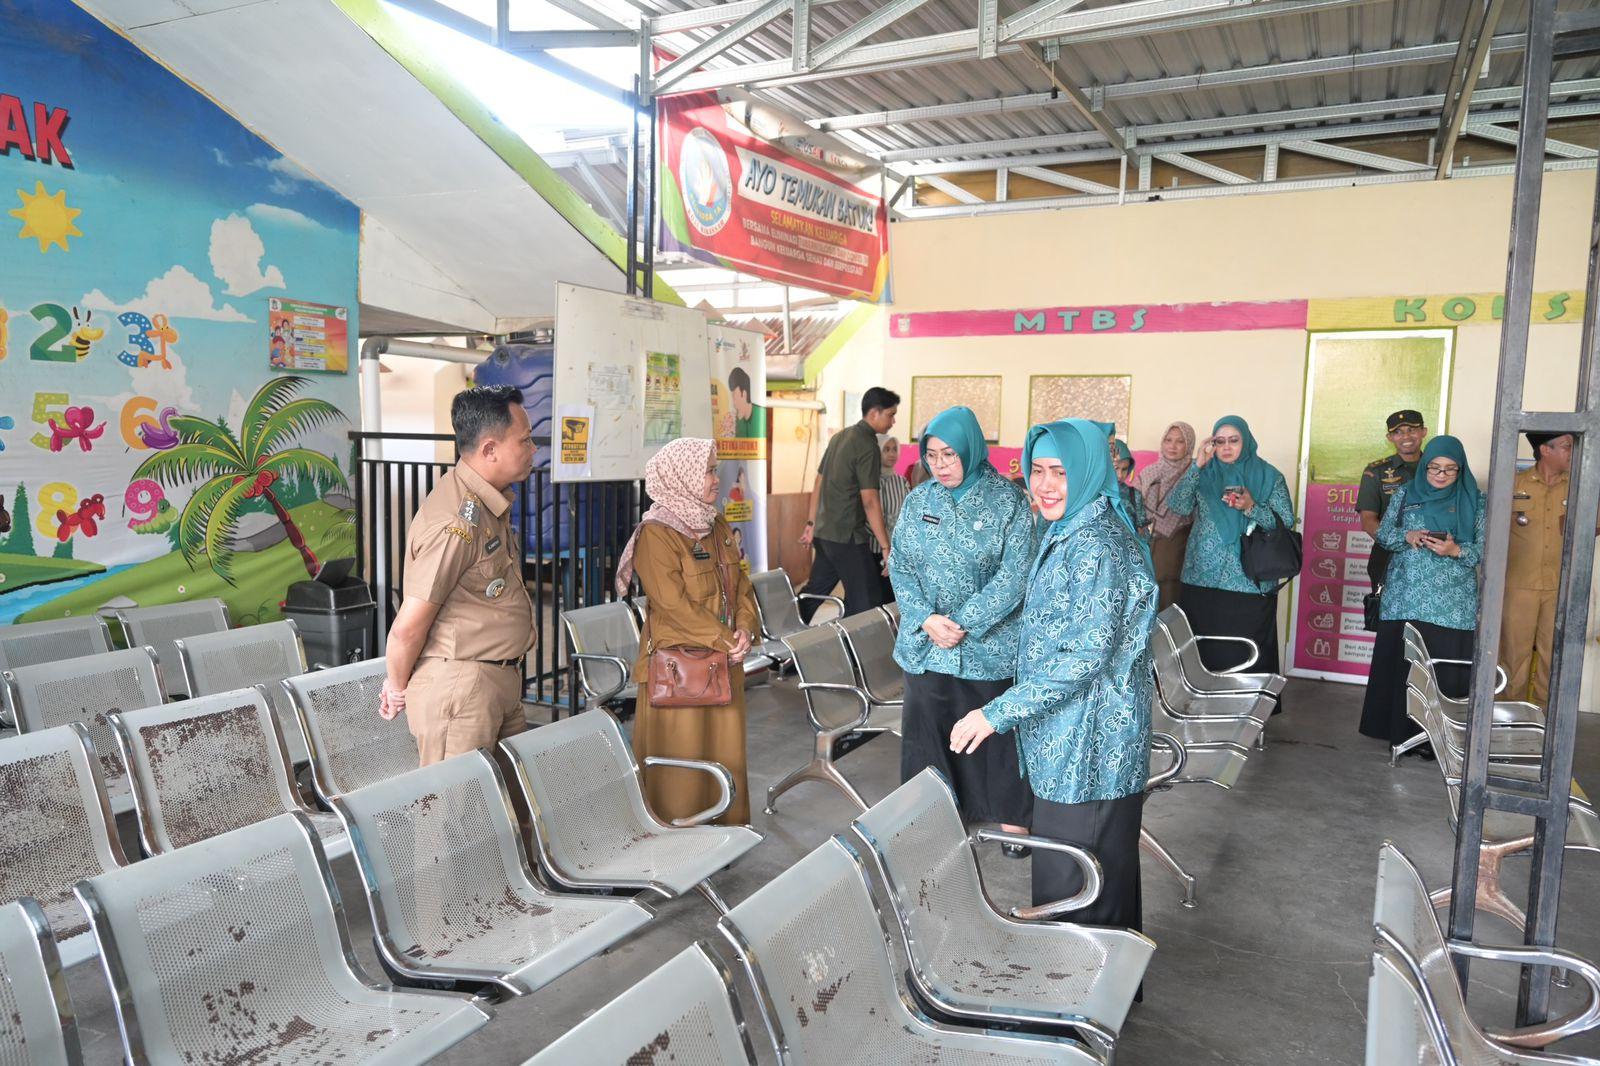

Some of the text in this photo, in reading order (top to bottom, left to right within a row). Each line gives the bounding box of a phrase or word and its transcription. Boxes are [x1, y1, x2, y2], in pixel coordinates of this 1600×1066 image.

[0, 93, 74, 170] AK
[745, 158, 777, 195] AYO
[781, 172, 836, 219] TEMUKAN
[742, 217, 770, 237] BERSAMA
[771, 210, 814, 237] SELAMATKAN
[815, 226, 848, 246] KELUARGA
[1014, 308, 1148, 332] MTBS
